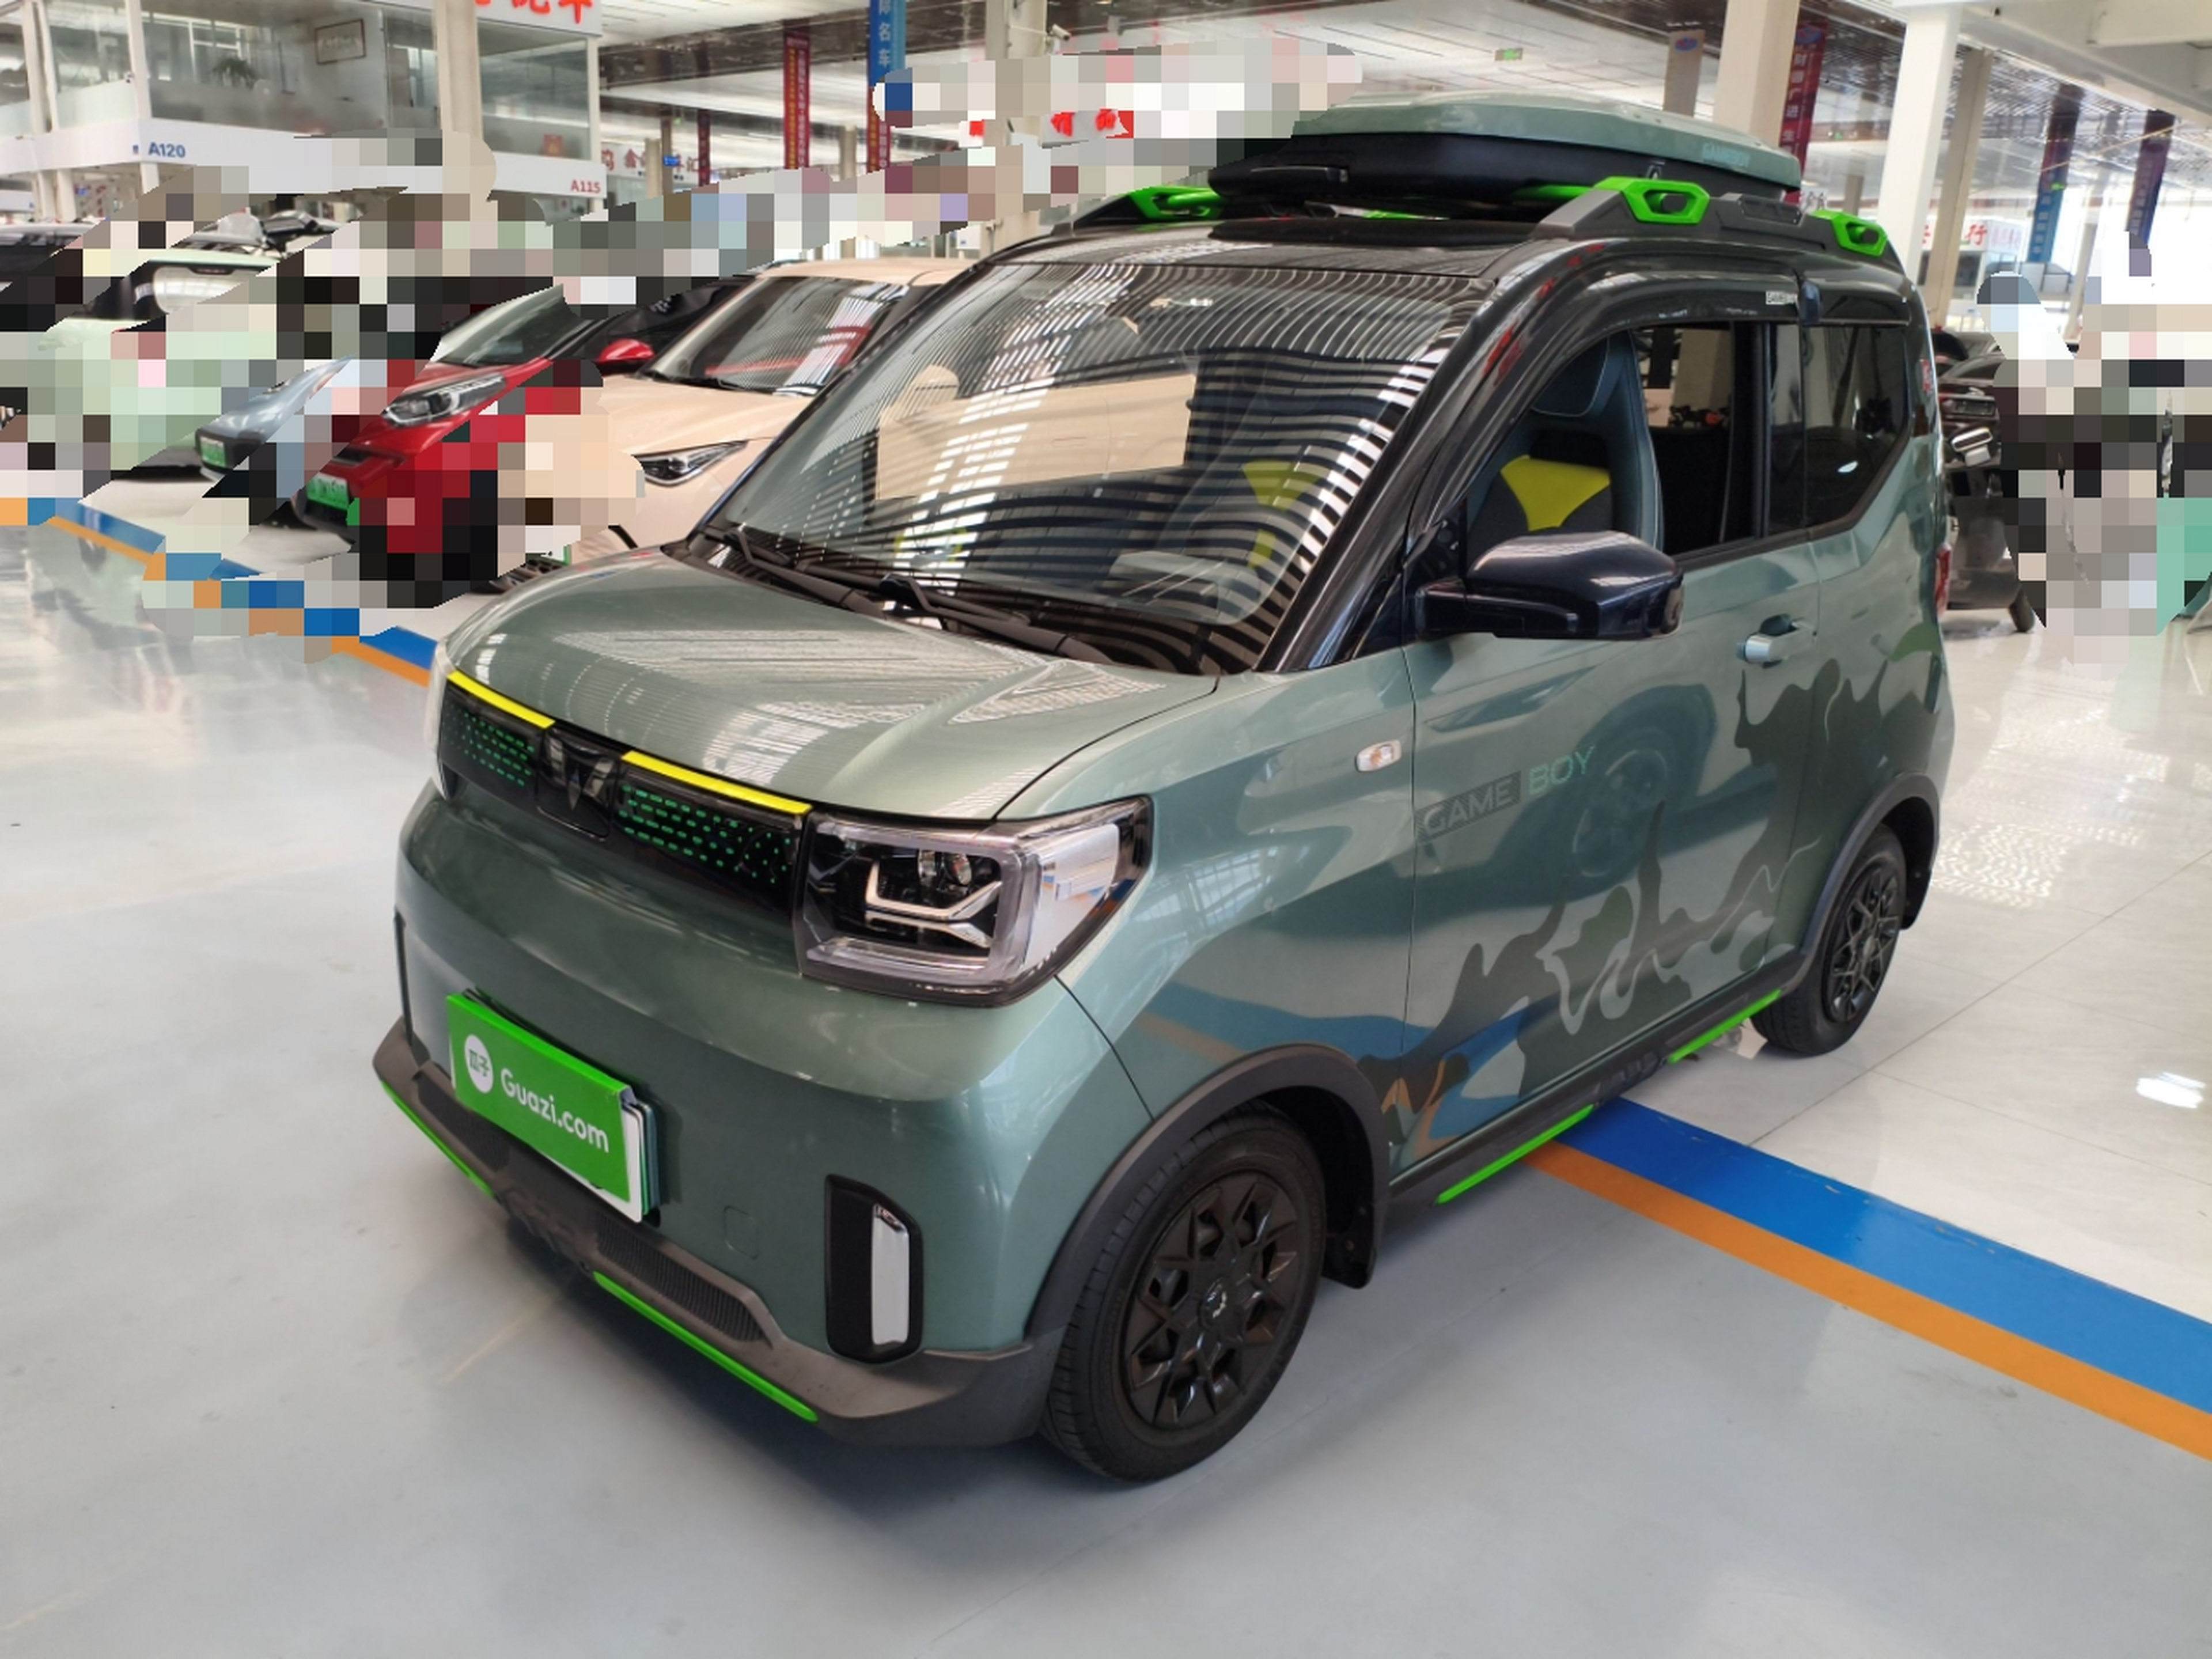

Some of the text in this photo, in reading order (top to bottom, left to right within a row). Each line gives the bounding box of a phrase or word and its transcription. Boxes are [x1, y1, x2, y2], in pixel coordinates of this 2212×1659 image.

[148, 141, 186, 158] A120
[571, 179, 601, 194] A115
[1424, 745, 1595, 836] GAME BOY
[500, 1067, 609, 1153] Guazi.com
